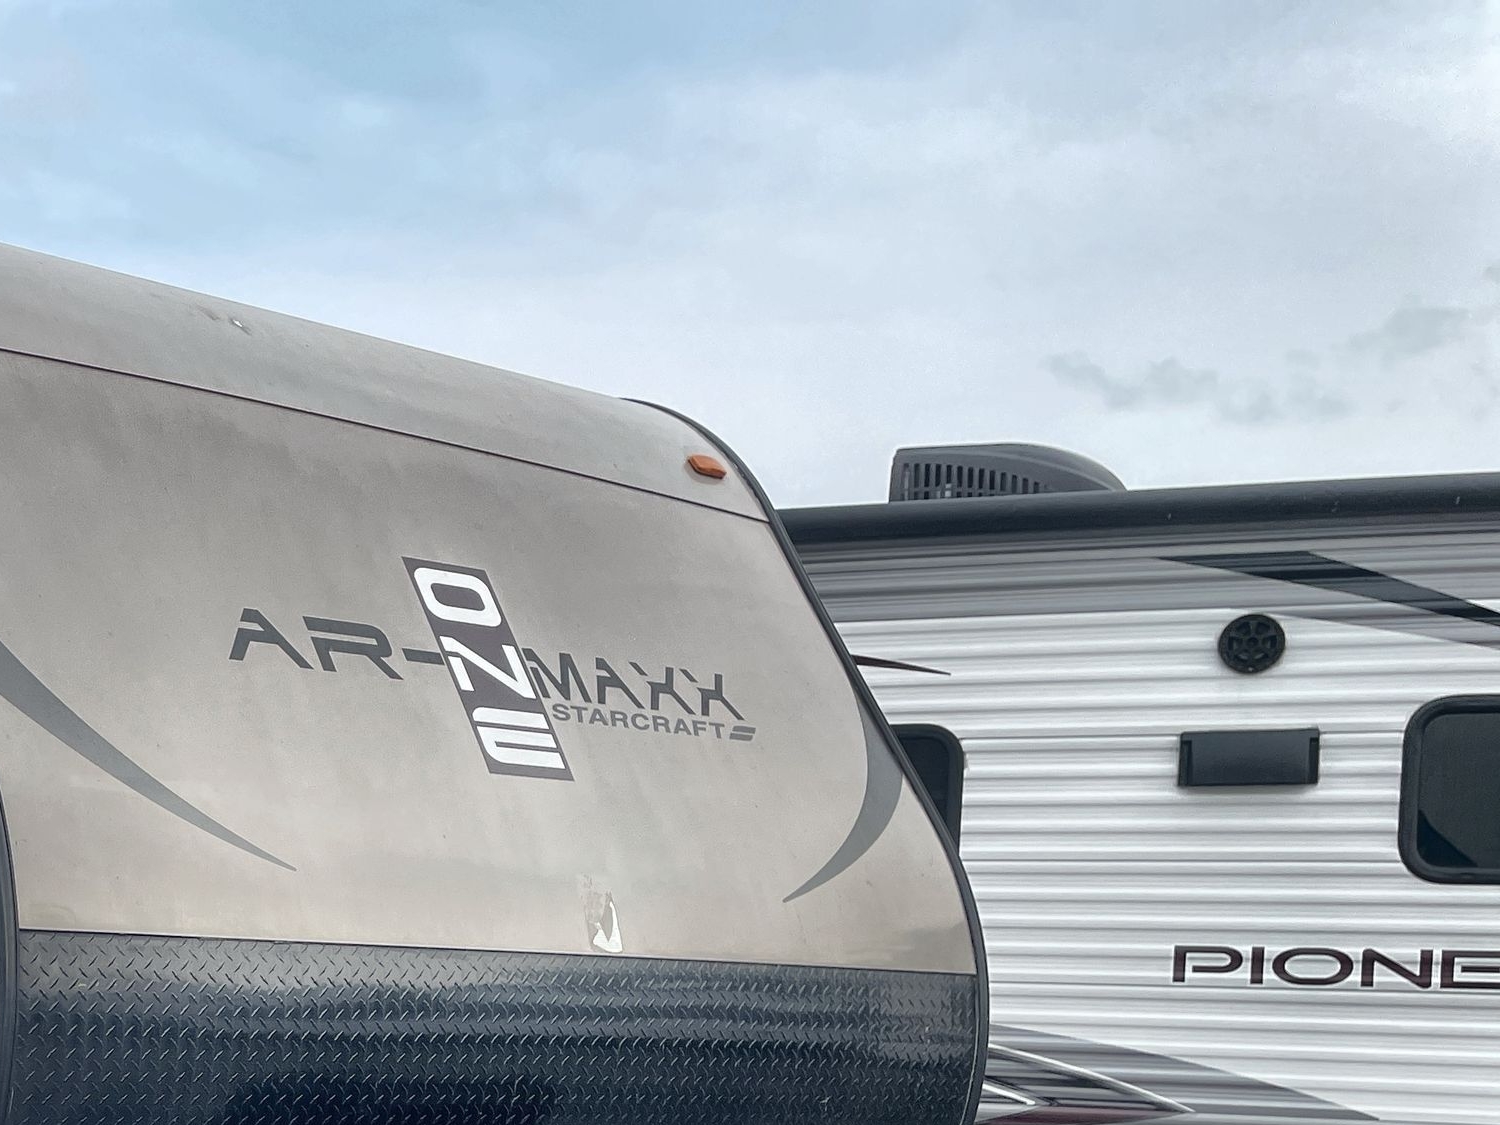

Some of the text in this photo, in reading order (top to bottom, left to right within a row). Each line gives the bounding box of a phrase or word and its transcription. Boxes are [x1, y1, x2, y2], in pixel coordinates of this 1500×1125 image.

[413, 566, 566, 770] ONE
[521, 646, 745, 721] MAXX
[551, 702, 726, 741] STARCRAFT
[1172, 944, 1500, 990] PIONE
